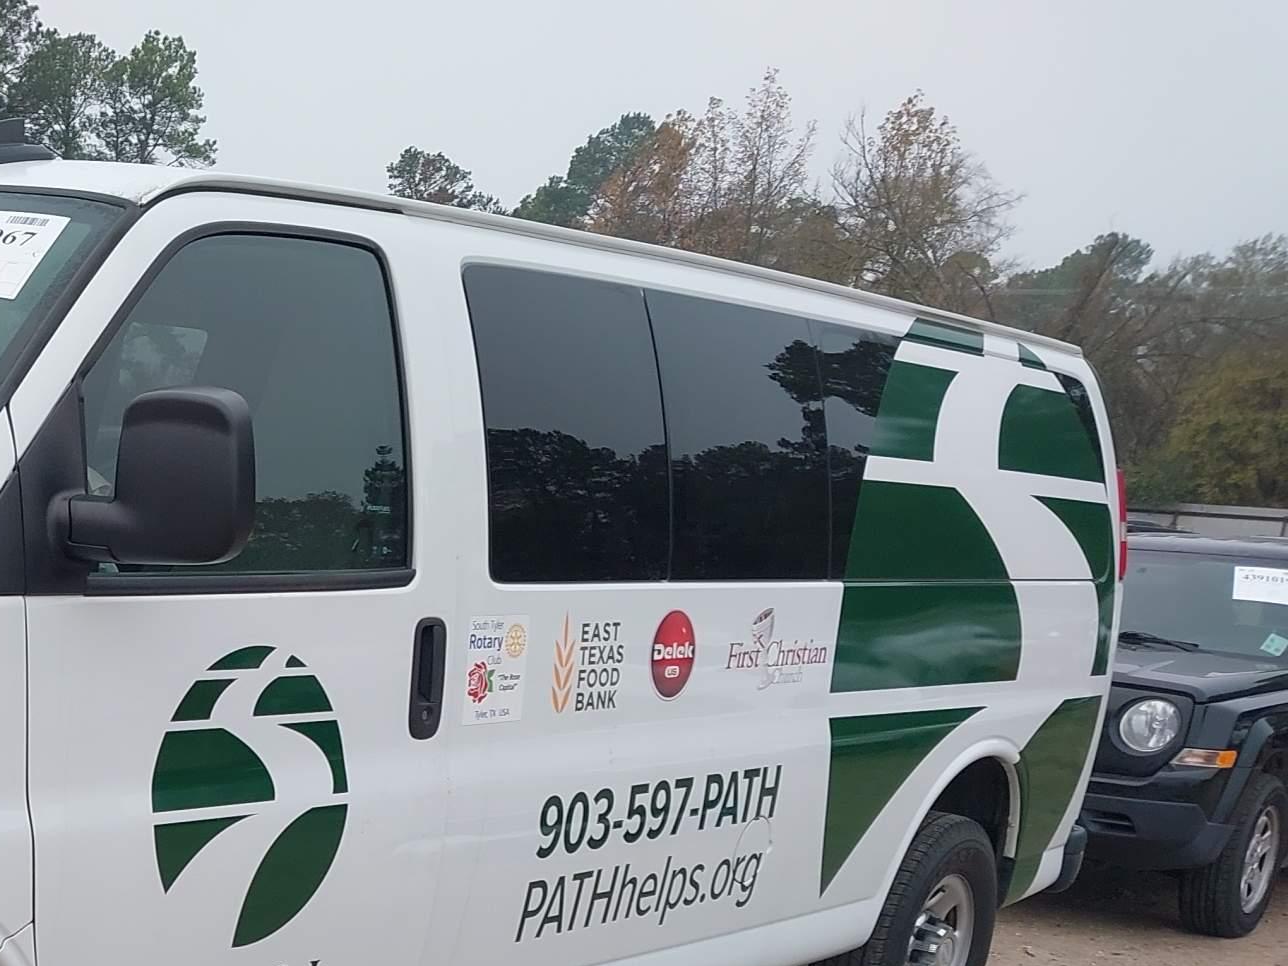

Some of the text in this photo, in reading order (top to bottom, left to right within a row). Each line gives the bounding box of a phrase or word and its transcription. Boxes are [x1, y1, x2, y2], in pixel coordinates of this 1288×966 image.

[469, 633, 504, 652] Rotary
[581, 622, 621, 643] EAST
[579, 644, 624, 666] TEXAS
[653, 641, 694, 661] Delek
[725, 639, 827, 669] First Christian
[576, 667, 620, 689] FOOD
[574, 689, 617, 712] BANK
[536, 765, 782, 859] 903-597-PATH
[515, 852, 763, 943] PATHhelps.org
